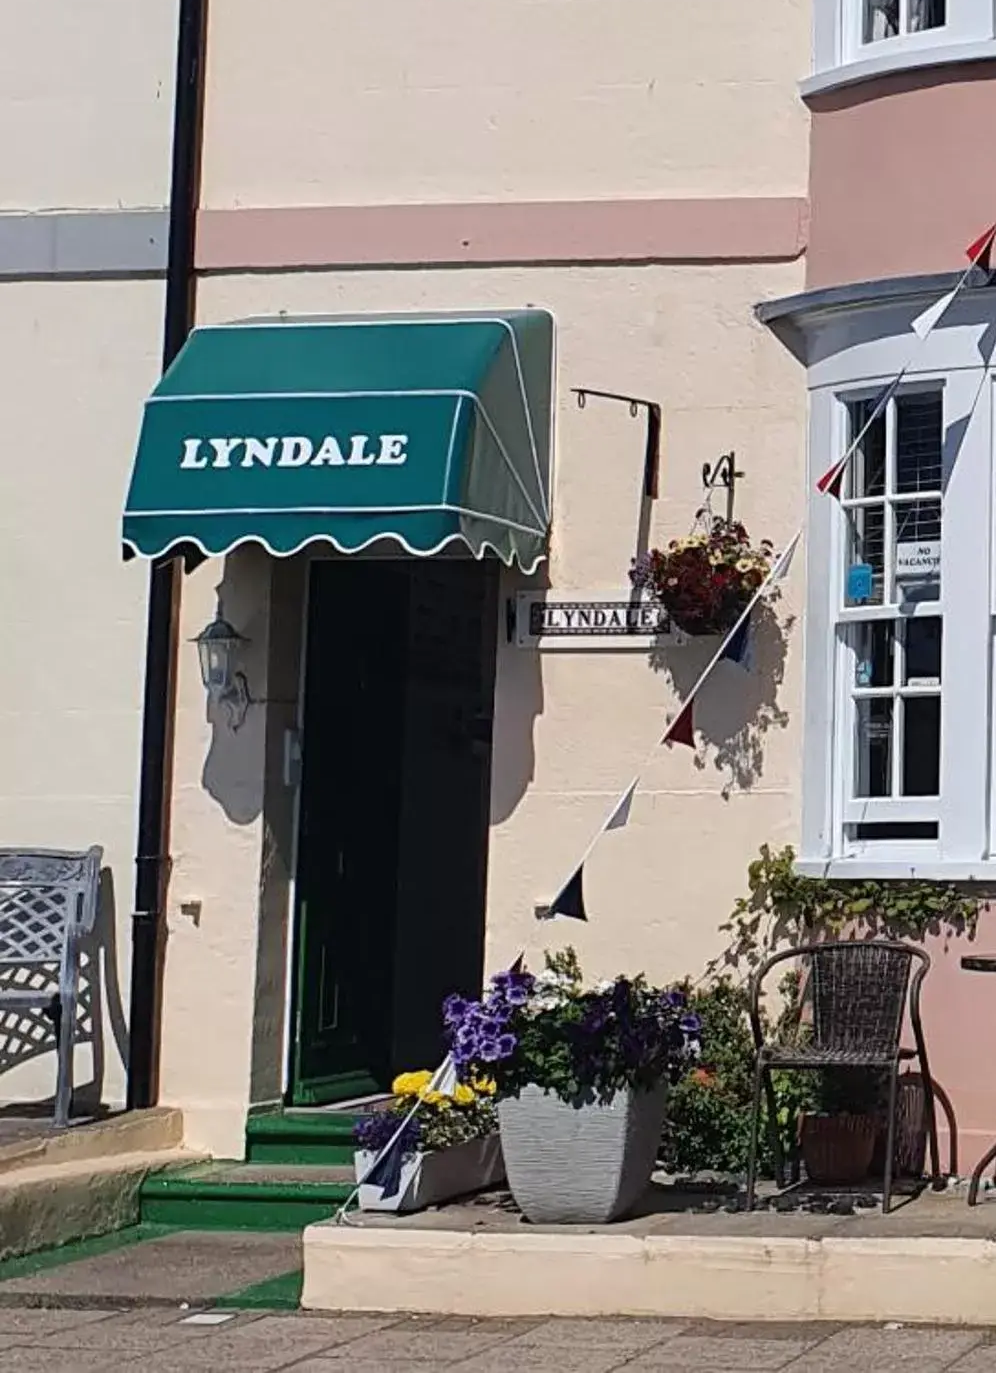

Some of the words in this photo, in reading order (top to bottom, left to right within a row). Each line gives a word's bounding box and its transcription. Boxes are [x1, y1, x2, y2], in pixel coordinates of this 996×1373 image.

[180, 434, 408, 469] LYNDALE
[917, 547, 931, 555] NO
[547, 609, 652, 627] LYNDALE
